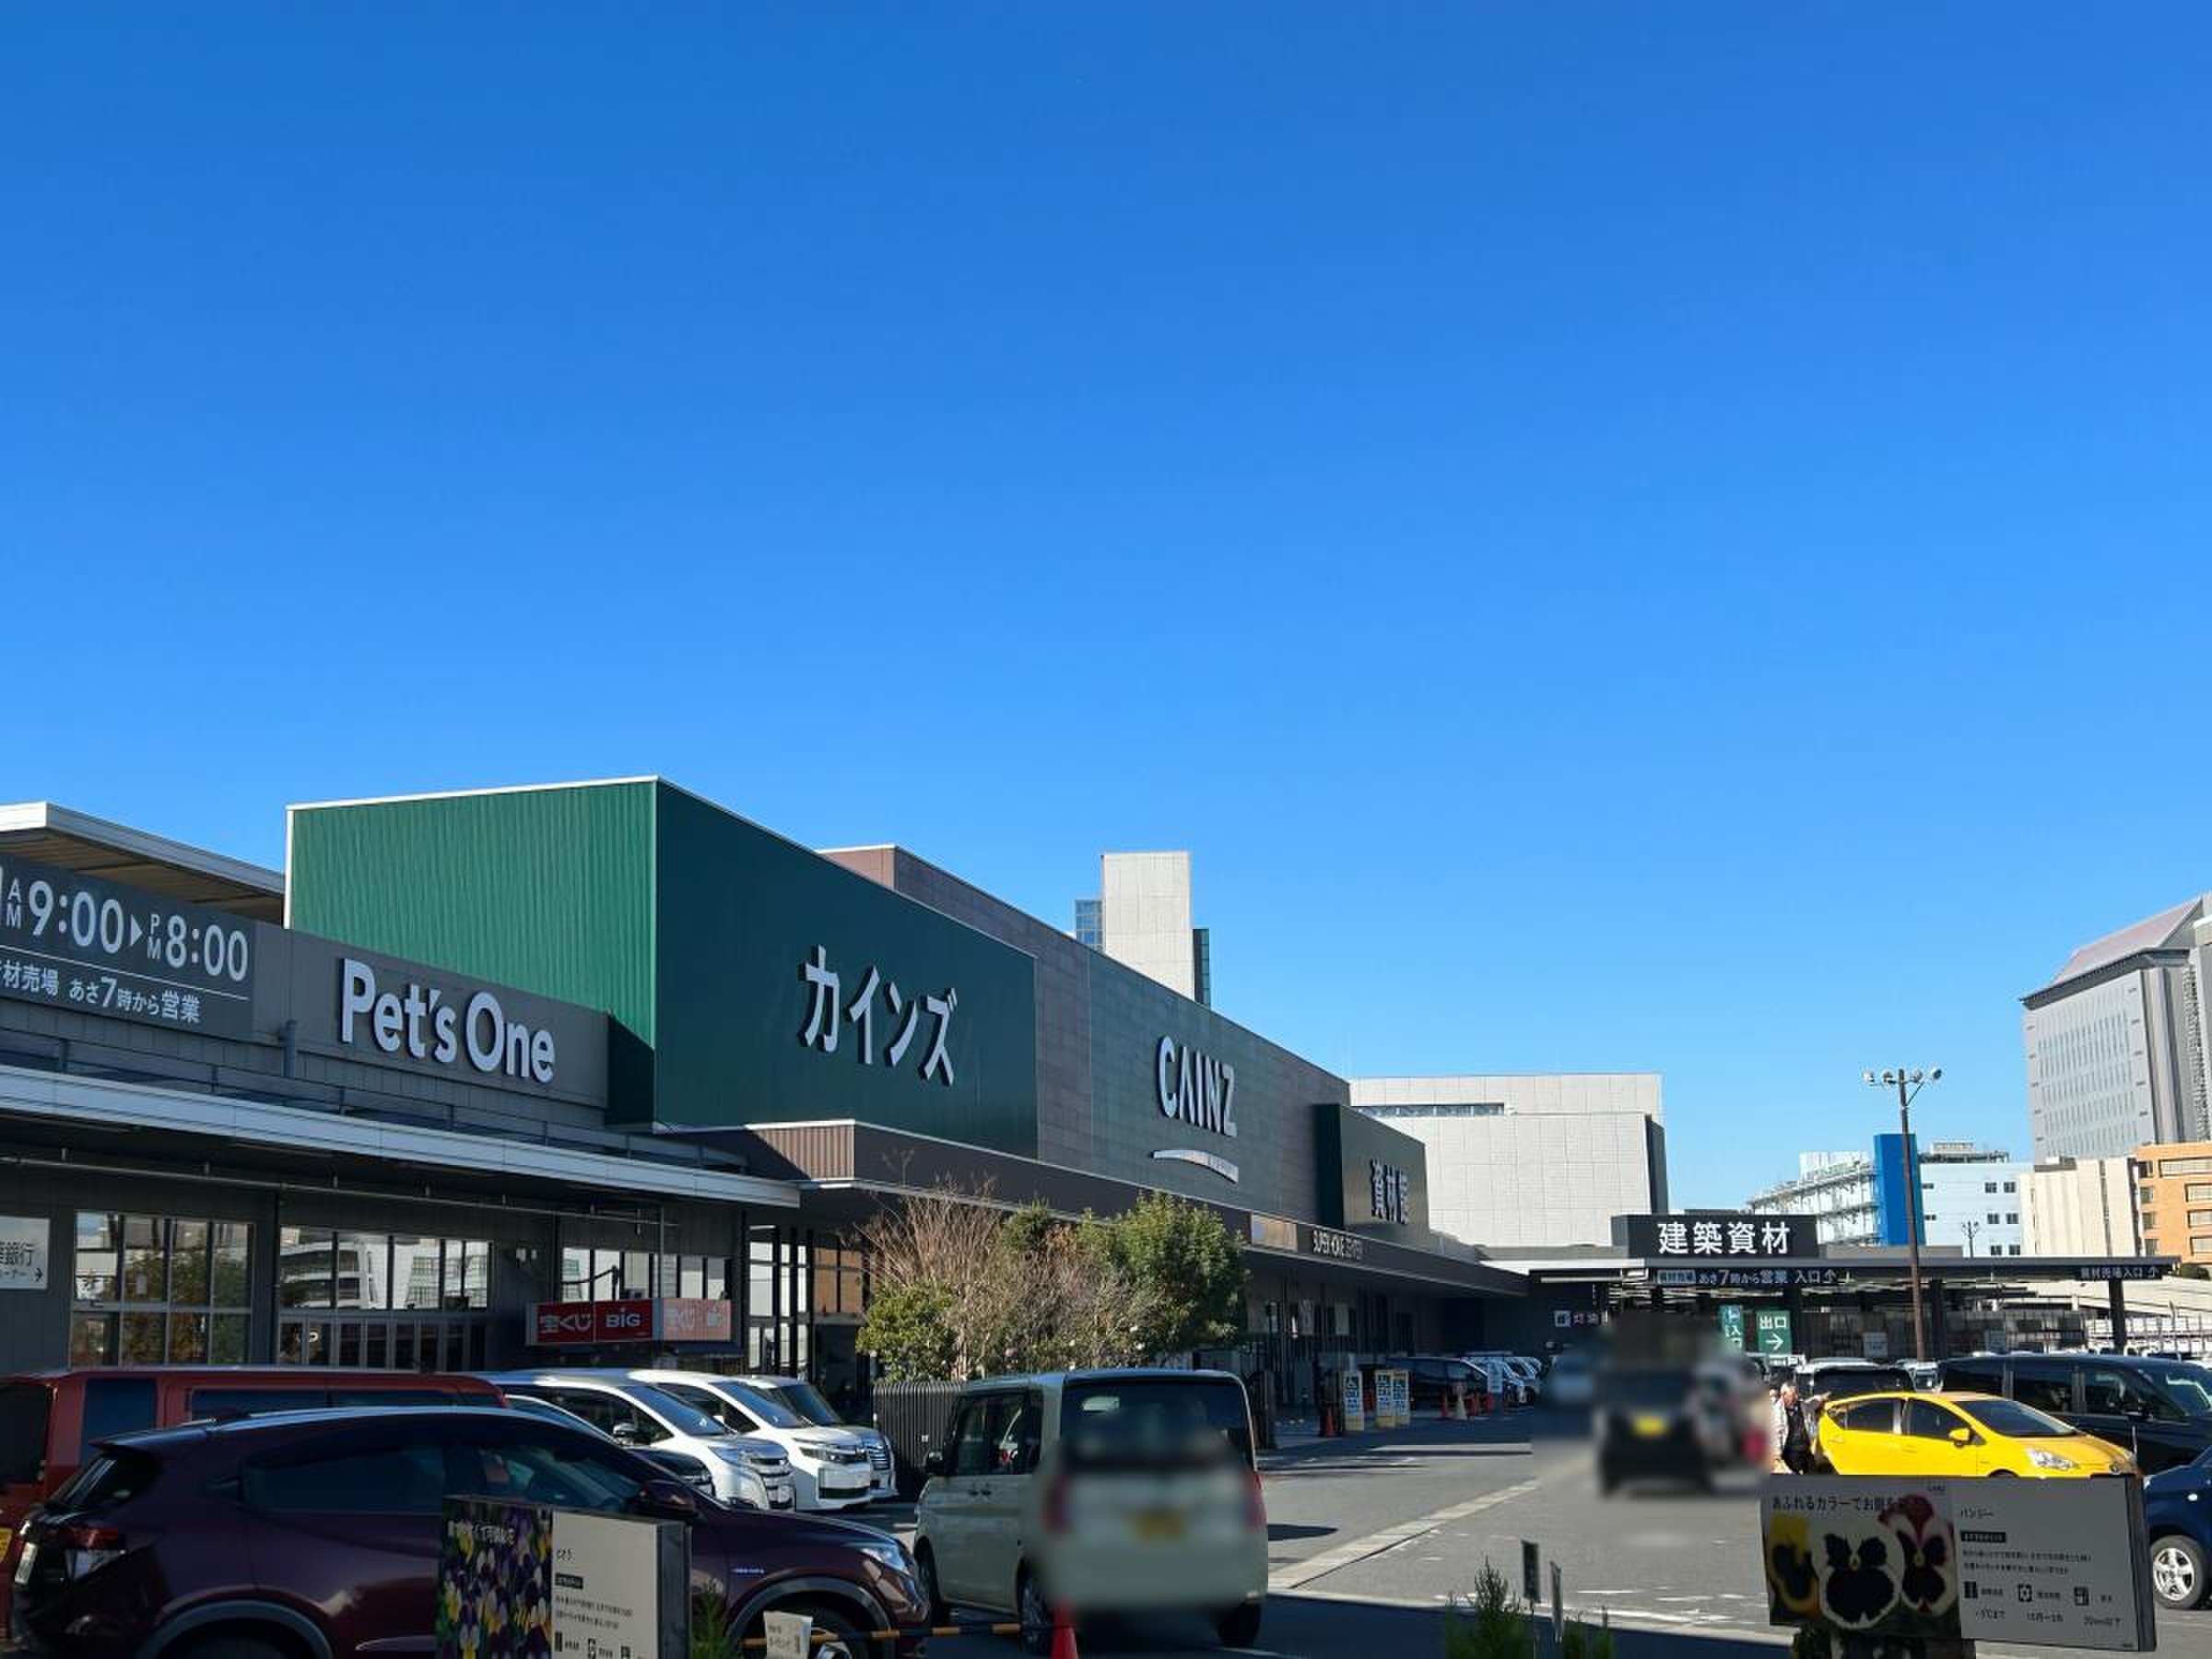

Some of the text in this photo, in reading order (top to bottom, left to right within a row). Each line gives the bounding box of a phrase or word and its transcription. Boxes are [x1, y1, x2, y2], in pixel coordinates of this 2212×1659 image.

[29, 880, 124, 953] 9:00
[166, 914, 249, 982] 8:00
[69, 976, 201, 1024] あさ7時から営業
[339, 959, 556, 1084] Pet's One
[799, 944, 959, 1088] カインズ
[1158, 1034, 1239, 1139] CAINZ
[0, 1240, 34, 1266] 銀行
[1657, 1221, 1792, 1255] 建築資材
[606, 1309, 642, 1328] BIG
[1759, 1315, 1787, 1330] 出口
